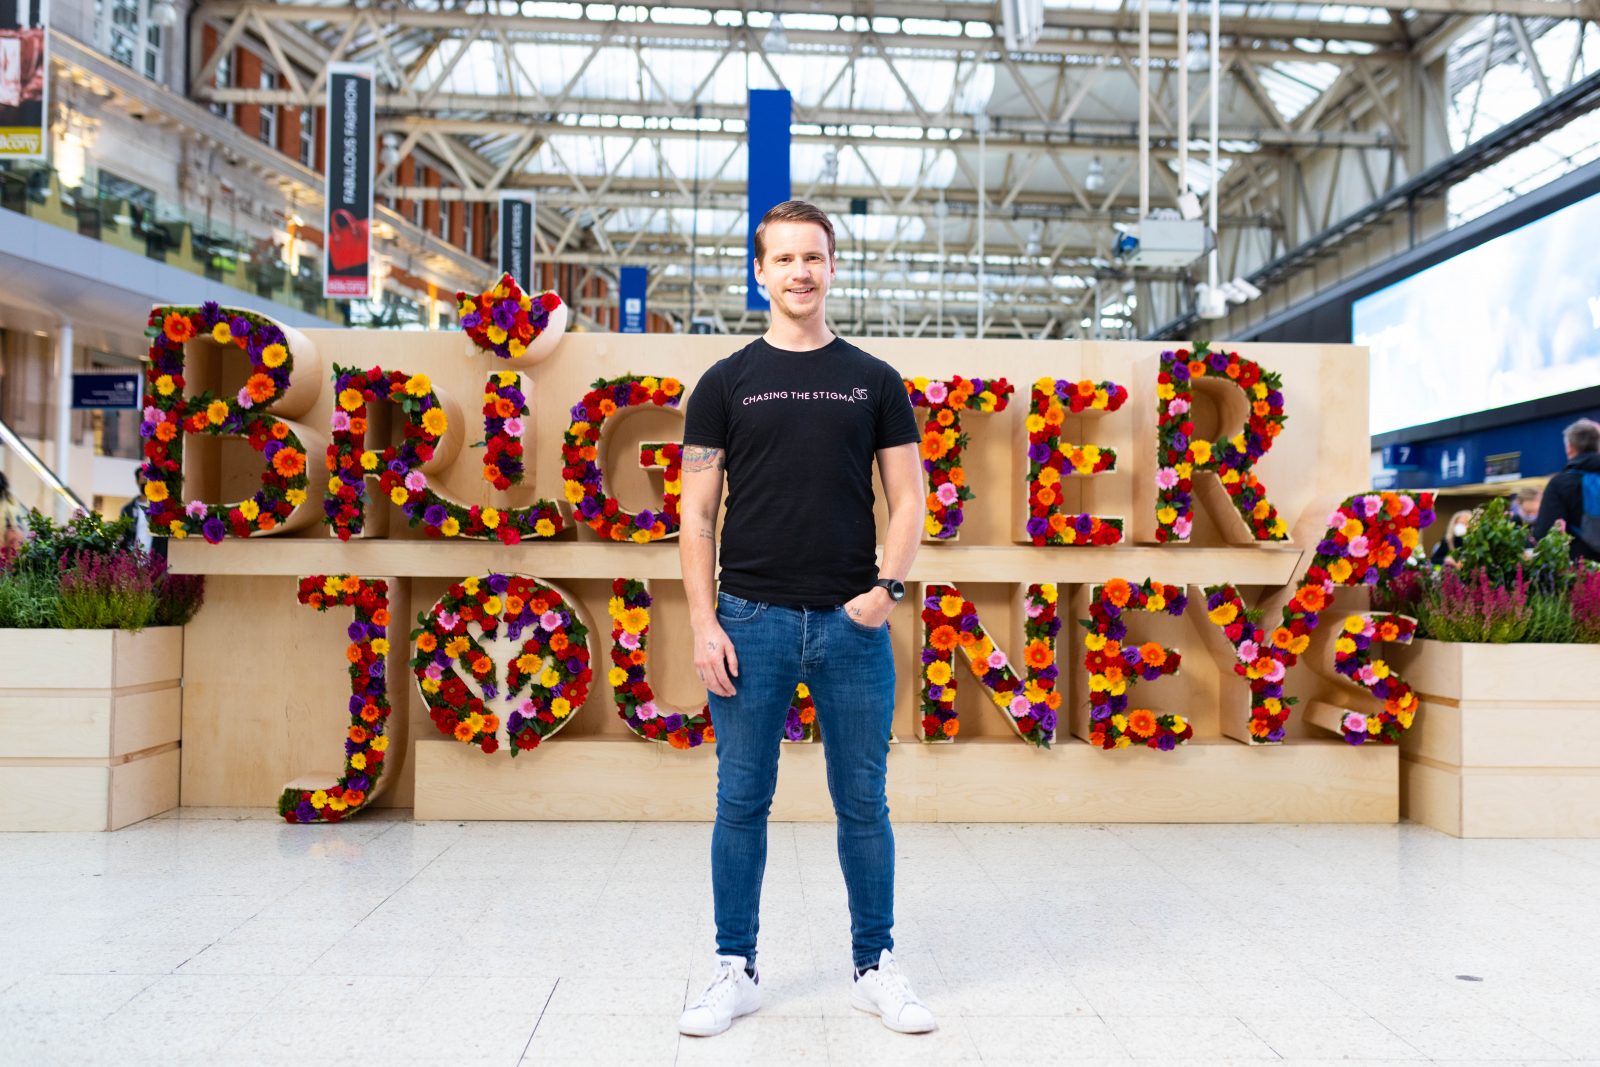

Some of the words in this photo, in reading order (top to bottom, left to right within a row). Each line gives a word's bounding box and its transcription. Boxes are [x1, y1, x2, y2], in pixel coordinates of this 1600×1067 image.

[344, 78, 358, 137] FASHION
[343, 137, 358, 204] FABULOUS
[140, 272, 1294, 545] BRIGTER
[742, 391, 788, 405] CHASING
[791, 391, 811, 400] THE
[812, 391, 855, 403] STIGMA
[1399, 446, 1411, 464] 7
